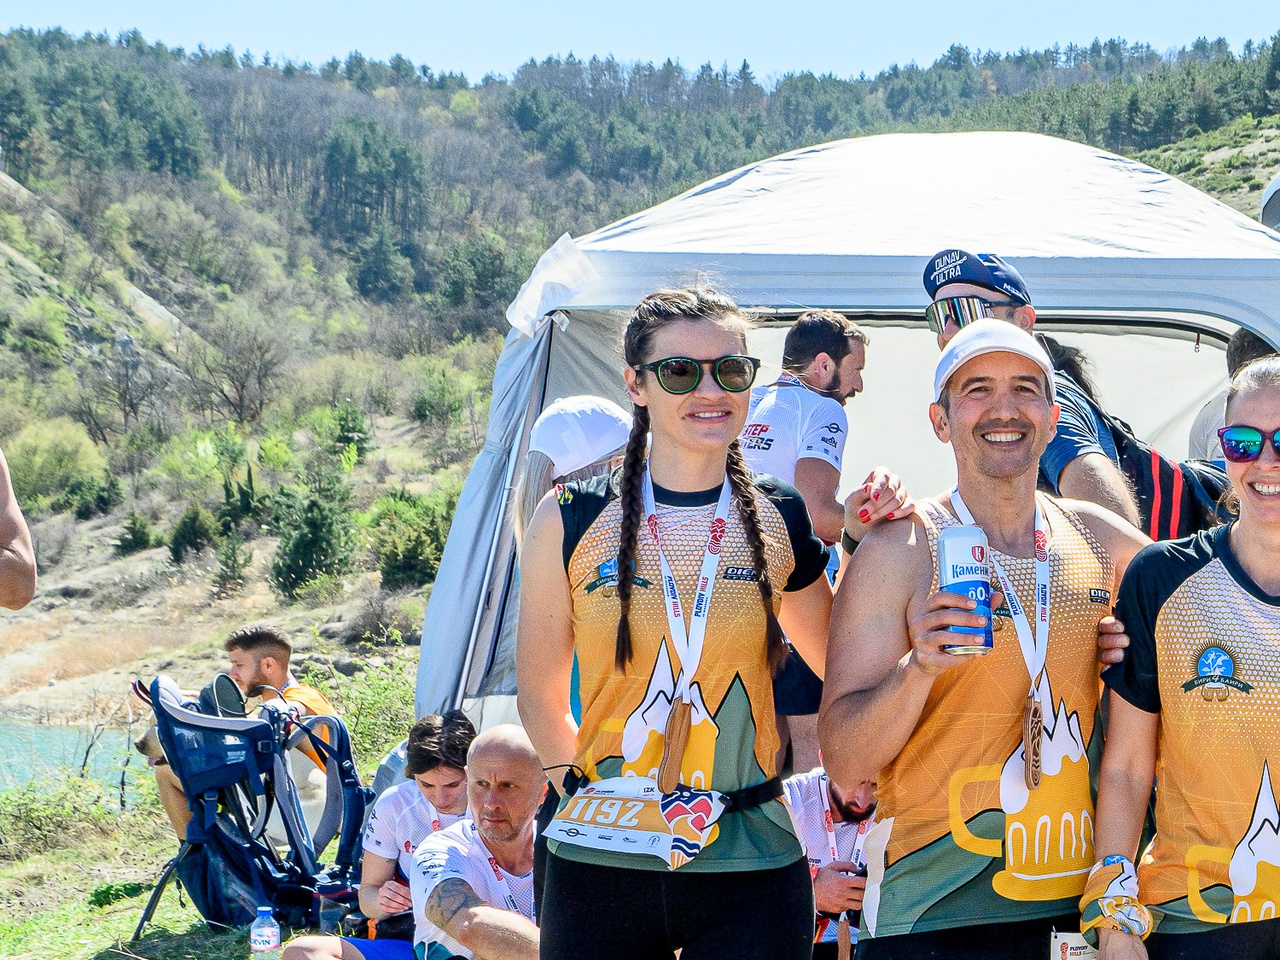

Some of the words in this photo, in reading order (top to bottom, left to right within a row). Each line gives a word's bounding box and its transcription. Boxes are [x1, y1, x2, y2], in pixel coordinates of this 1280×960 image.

[934, 250, 961, 271] DUNAV
[935, 265, 962, 286] ULTRA
[569, 798, 645, 827] 1192
